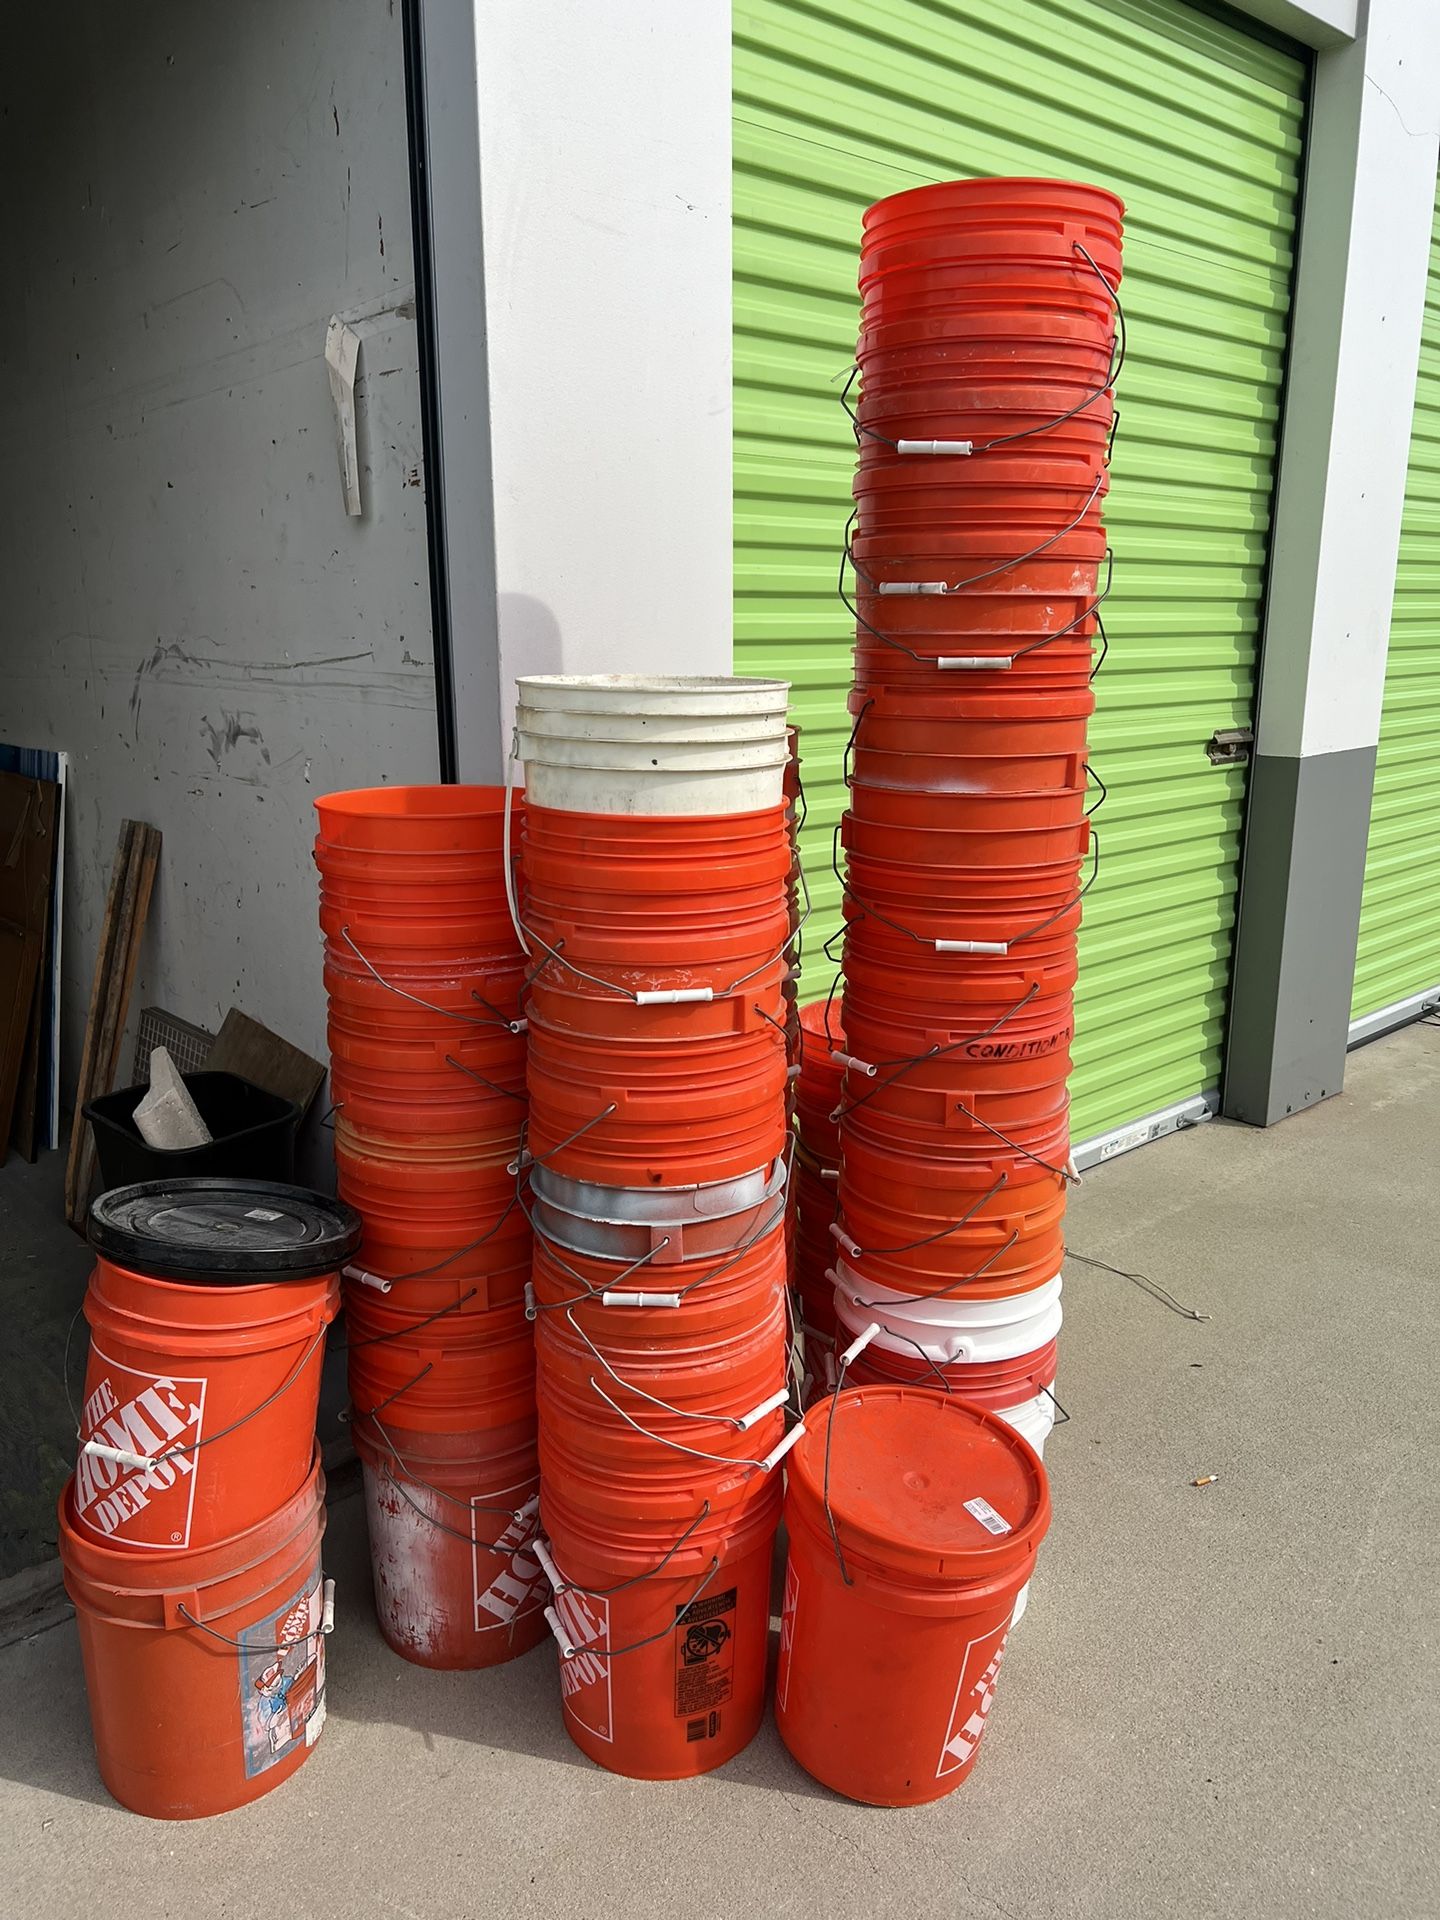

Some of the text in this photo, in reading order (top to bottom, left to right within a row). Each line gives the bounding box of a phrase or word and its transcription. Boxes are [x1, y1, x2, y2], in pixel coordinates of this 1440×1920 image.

[75, 1379, 201, 1515] HOME
[84, 1377, 120, 1434] THE
[94, 1441, 194, 1534] DEPOT
[945, 1664, 1001, 1762] HO
